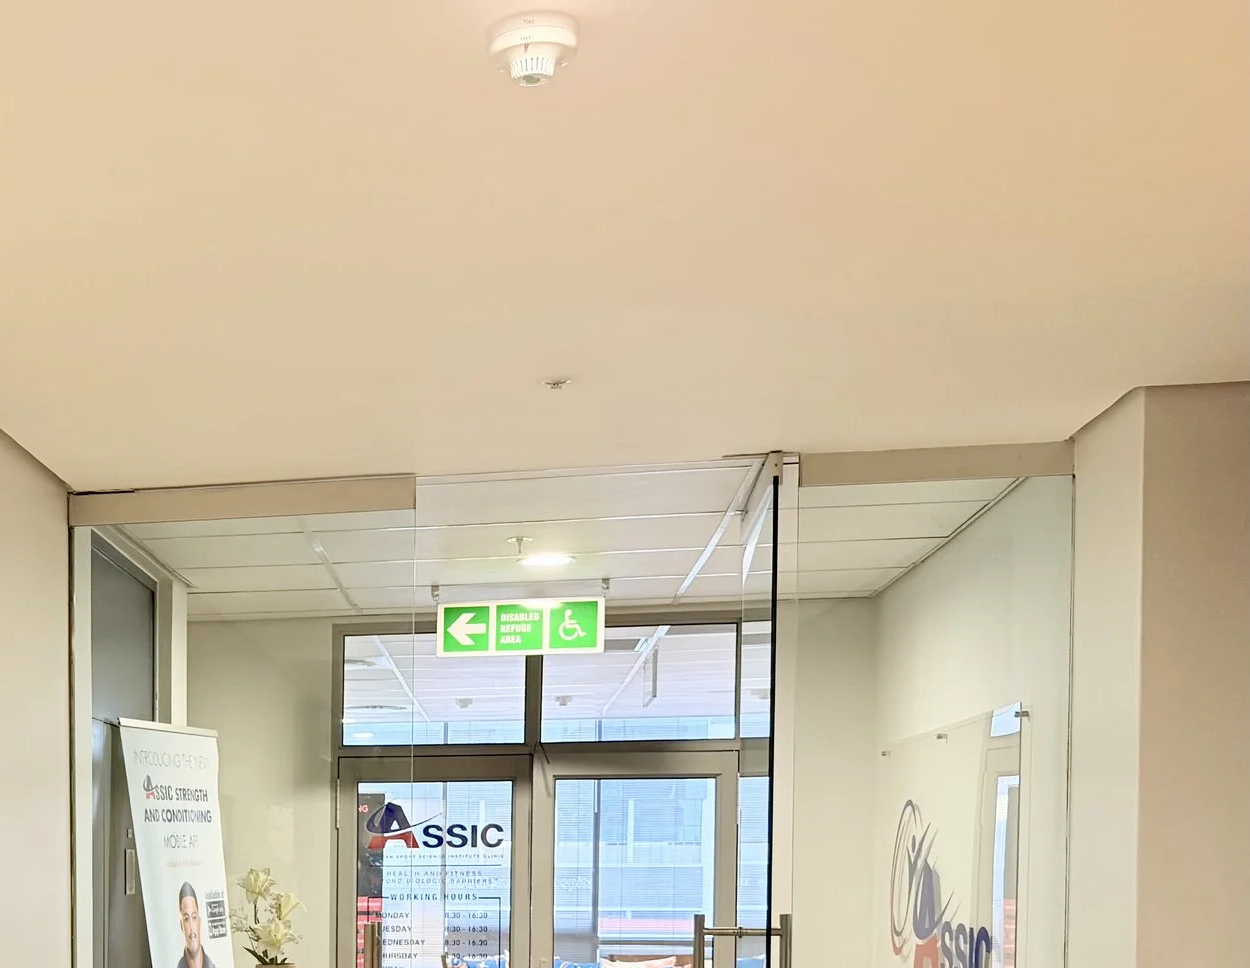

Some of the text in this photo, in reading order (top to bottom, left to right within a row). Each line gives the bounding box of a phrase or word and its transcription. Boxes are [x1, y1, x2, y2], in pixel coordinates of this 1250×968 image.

[500, 612, 540, 622] DISABLED
[500, 623, 532, 633] REFUGE
[500, 635, 521, 644] AREA
[175, 787, 209, 802] STRENGTH
[144, 808, 212, 823] AND CONDITIONING
[366, 801, 504, 849] ASSIC
[468, 911, 488, 919] 16:30
[382, 925, 412, 933] UESDAY
[382, 938, 425, 946] EDNESDAY
